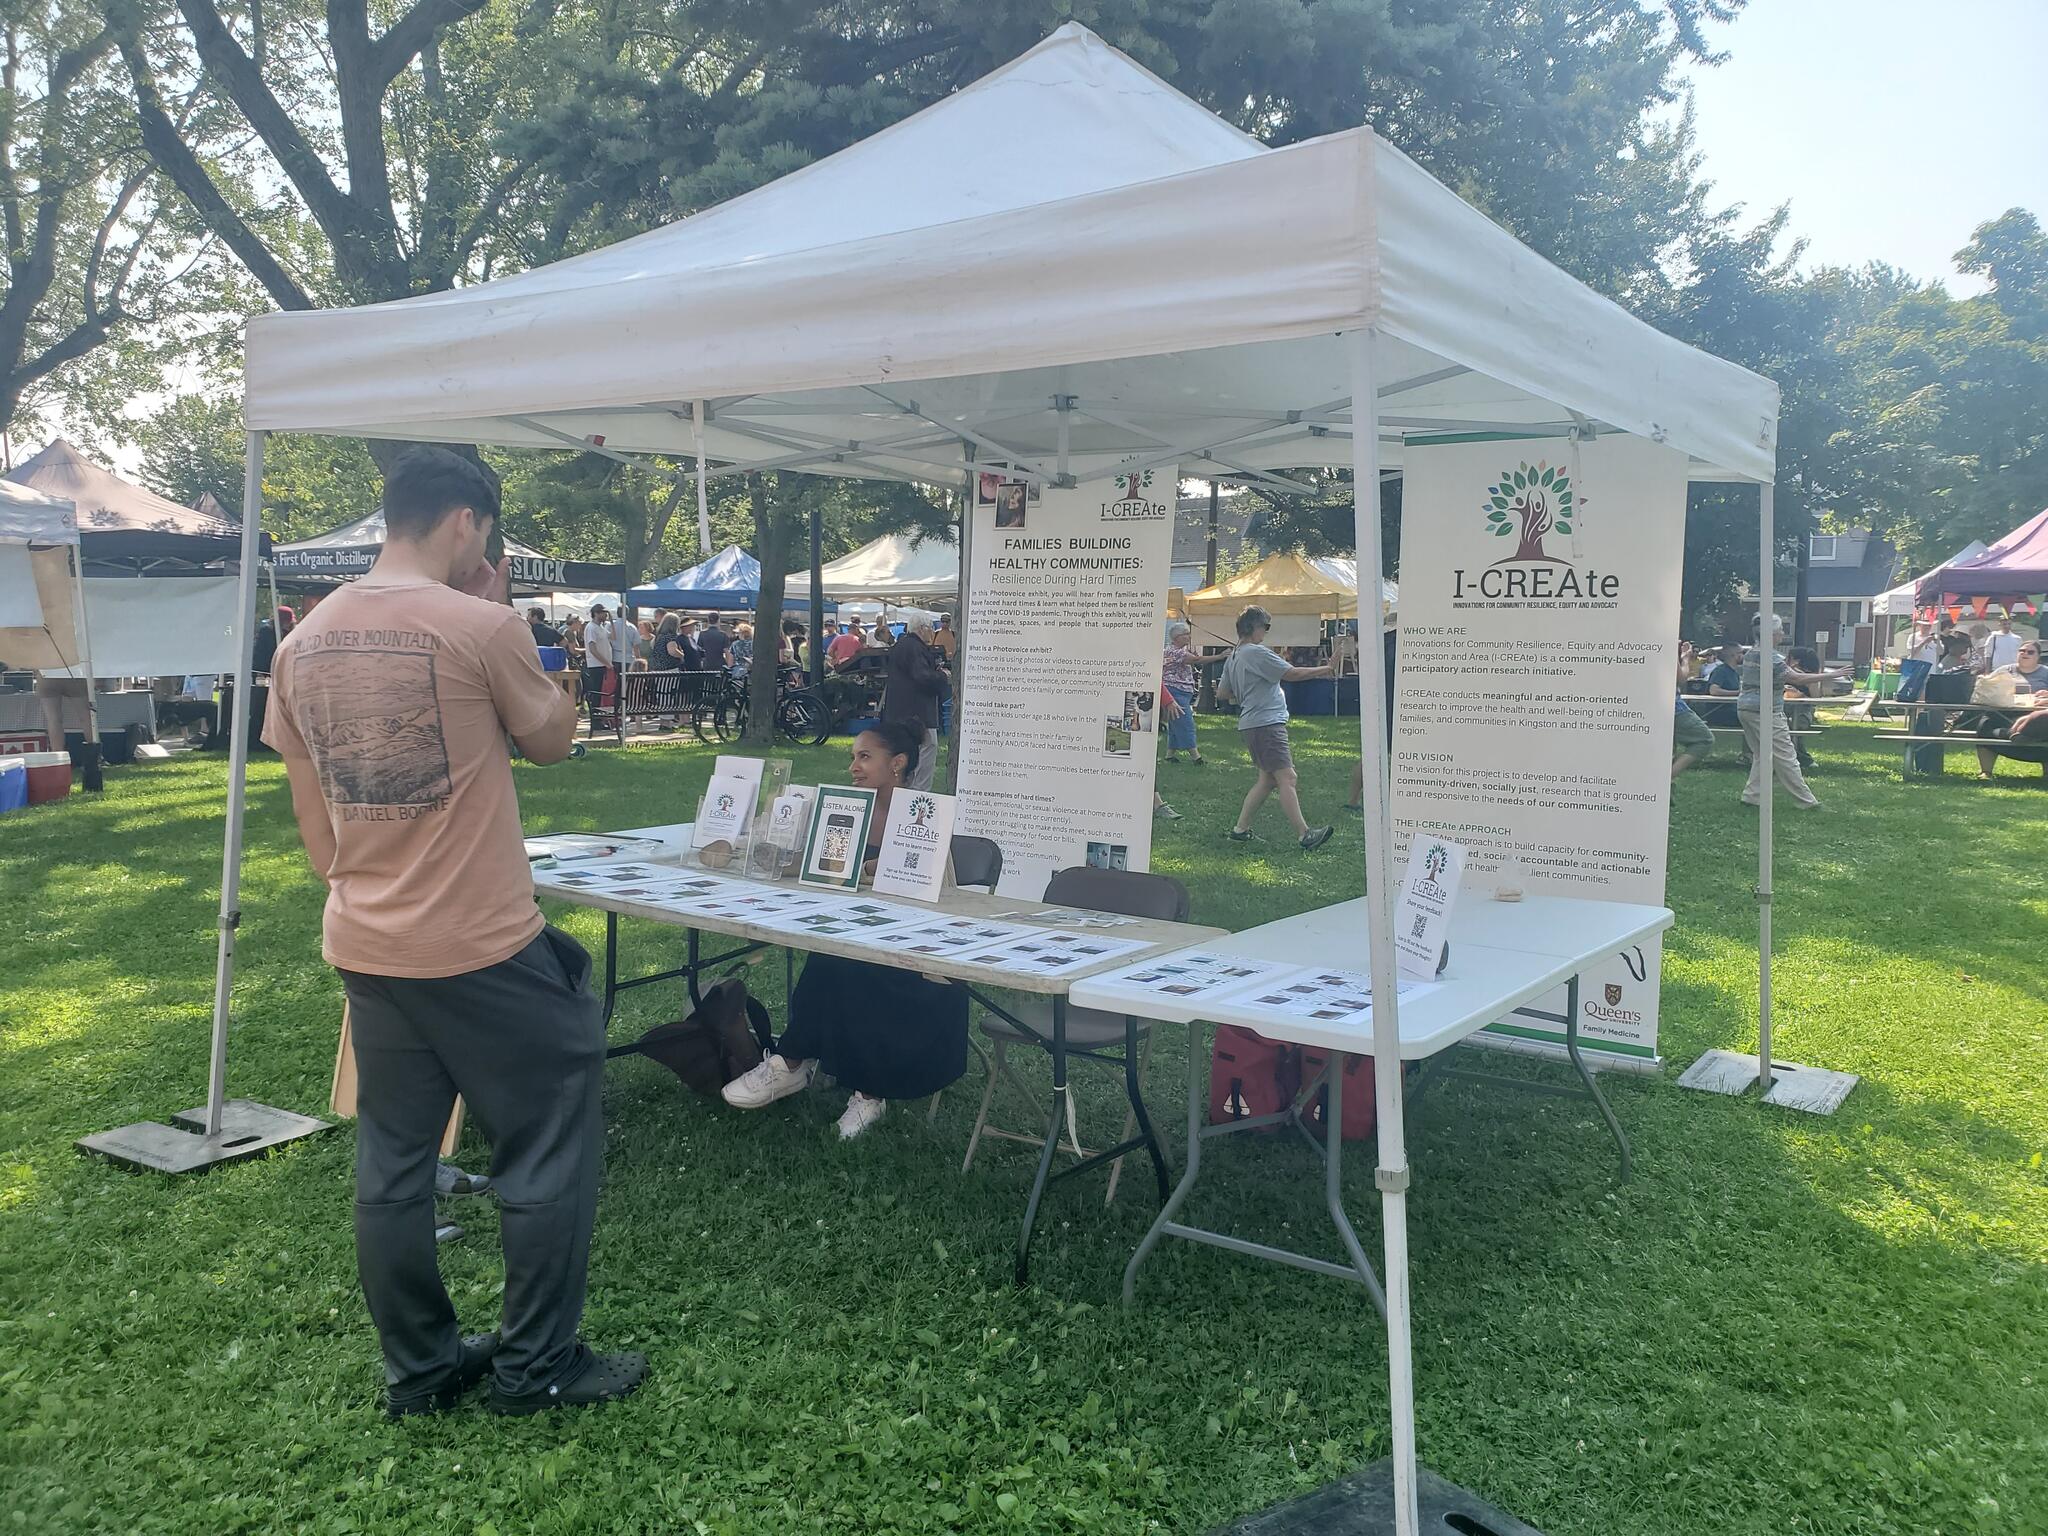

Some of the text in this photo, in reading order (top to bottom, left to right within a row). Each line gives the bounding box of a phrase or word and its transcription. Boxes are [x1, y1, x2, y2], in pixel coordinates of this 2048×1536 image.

[1101, 502, 1166, 516] I-CREAte
[1004, 538, 1130, 549] FAMILIES BUILDING
[280, 552, 299, 566] First
[301, 552, 333, 569] Organic
[336, 552, 376, 568] Distillery
[989, 557, 1143, 569] HEALTHY COMMUNITIES:
[509, 556, 566, 583] SLOCK
[991, 574, 1136, 586] Resilience During Hard Times
[1453, 568, 1619, 598] I-CREAte
[325, 631, 359, 647] OVER
[364, 630, 441, 650] MOUNTAIN
[1466, 640, 1514, 650] Community
[1516, 640, 1564, 649] Resilience,
[1567, 641, 1596, 651] Equity
[1617, 642, 1662, 652] Advocacy
[1411, 652, 1448, 661] Kingston
[1556, 655, 1645, 665] community-based
[1401, 664, 1458, 674] participatory
[1532, 667, 1575, 675] initiative.
[1442, 691, 1480, 699] conducts
[1482, 693, 1532, 702] meaningful
[1555, 695, 1628, 704] action-oriented
[1449, 703, 1482, 712] improve
[1500, 705, 1525, 713] health
[1547, 707, 1593, 718] well-being
[1606, 709, 1644, 718] children,
[1399, 714, 1433, 723] families,
[1453, 717, 1506, 725] communities
[1508, 718, 1518, 726] in
[1518, 719, 1557, 729] Kingston
[1596, 724, 1650, 734] surrounding
[1399, 728, 1427, 736] region.
[1420, 753, 1453, 761] VISION
[1472, 770, 1500, 779] project
[1521, 772, 1559, 783] develop
[1579, 775, 1616, 785] facilitate
[1396, 778, 1479, 790] community-driven,
[1482, 783, 1516, 793] socially
[1518, 784, 1538, 794] just,
[1541, 788, 1580, 796] research
[1583, 789, 1600, 798] that
[1613, 792, 1656, 802] grounded
[822, 802, 866, 813] LISTEN ALONG
[1424, 792, 1469, 800] responsive
[1481, 795, 1494, 803] the
[1557, 802, 1622, 812] communities.
[343, 807, 395, 821] DANIEL
[897, 824, 939, 840] I-CREAte
[1394, 818, 1511, 835] THE I-CREAte APPROACH
[1395, 831, 1410, 839] The
[1454, 837, 1492, 846] approach
[1514, 842, 1537, 850] build
[1537, 845, 1574, 855] capacity
[1577, 847, 1590, 855] for
[1592, 850, 1648, 863] community-
[1520, 857, 1578, 867] accountable
[1600, 864, 1650, 874] actionable
[1412, 879, 1446, 900] I-CREAte
[1584, 1000, 1641, 1022] Queen's
[1583, 1024, 1640, 1039] Family Medicine
